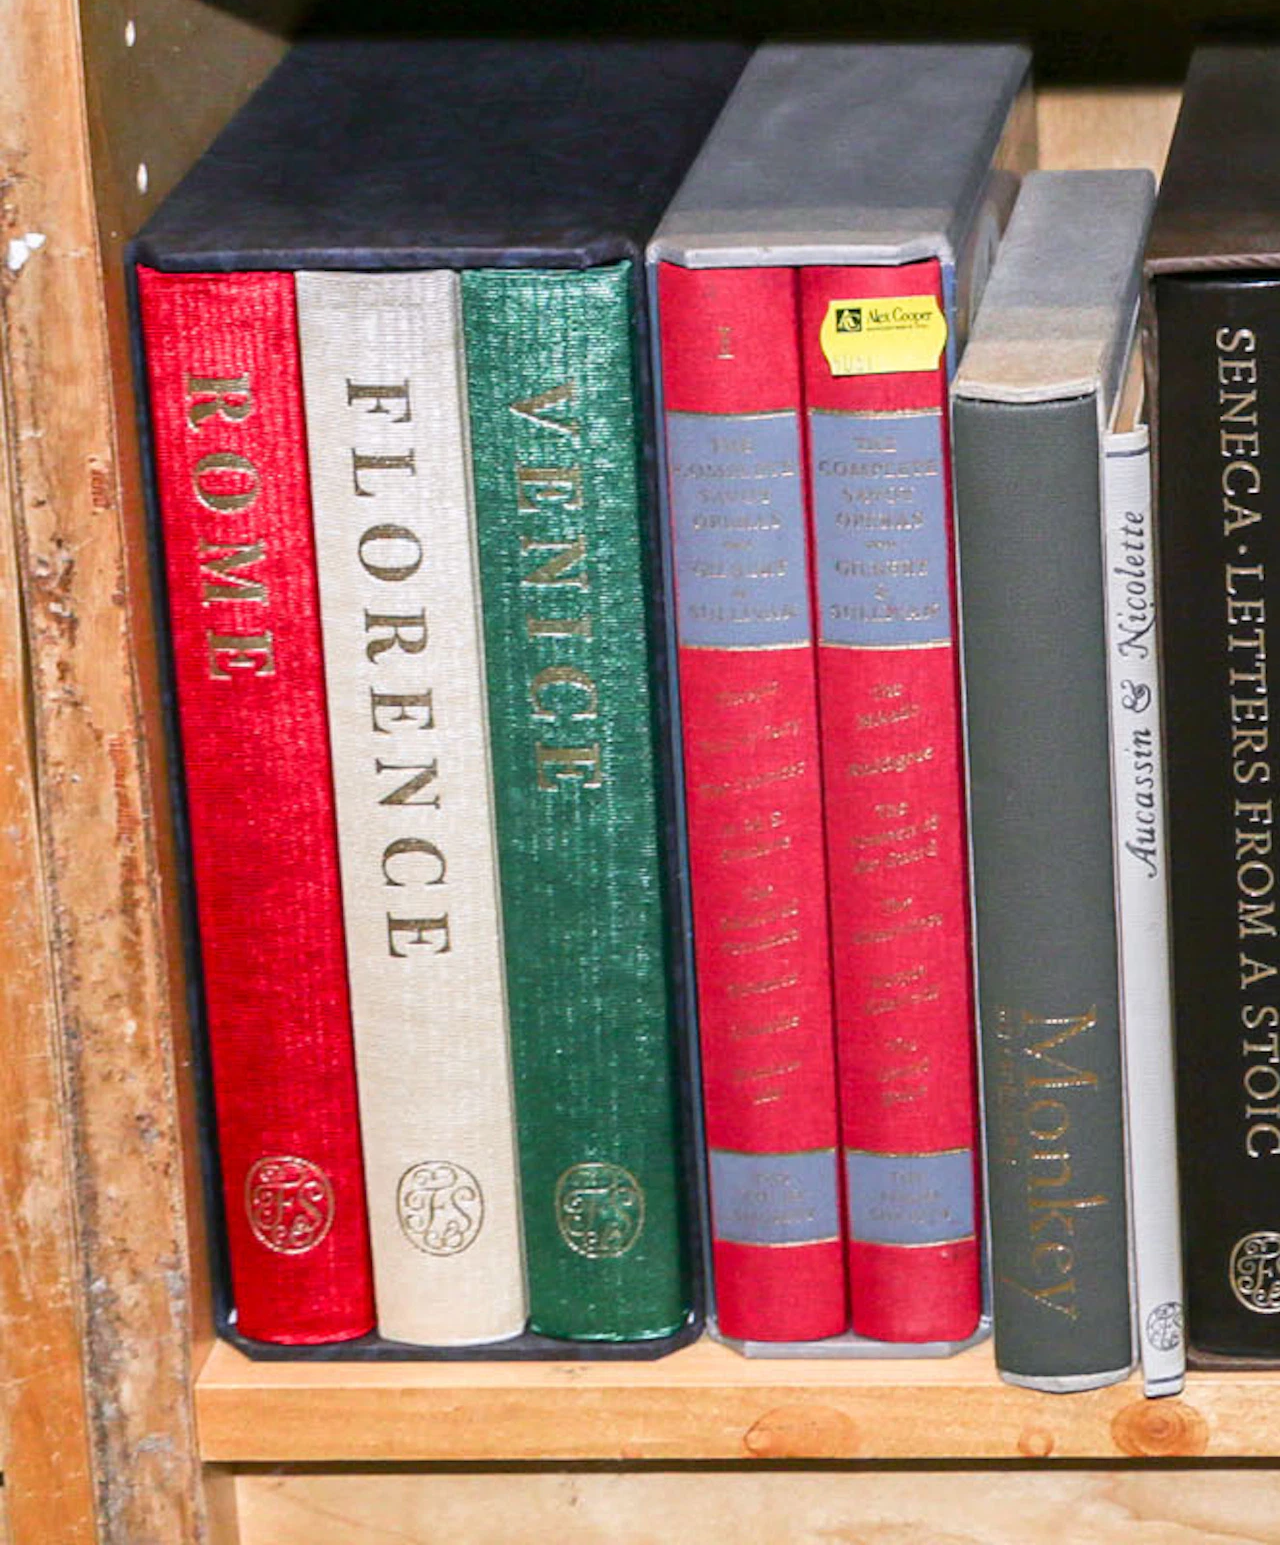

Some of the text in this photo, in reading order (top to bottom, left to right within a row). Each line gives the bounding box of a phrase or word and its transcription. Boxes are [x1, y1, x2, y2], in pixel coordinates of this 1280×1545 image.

[185, 372, 276, 680] ROME
[507, 377, 602, 791] VENICE
[1214, 325, 1264, 538] SENECA
[346, 377, 452, 958] FLORENCE
[1113, 509, 1159, 879] Aucassin & Nicolette
[1225, 561, 1272, 786] LETTERS
[1233, 798, 1278, 939] FROM
[1238, 952, 1279, 990] A
[997, 1004, 1110, 1320] Monkey
